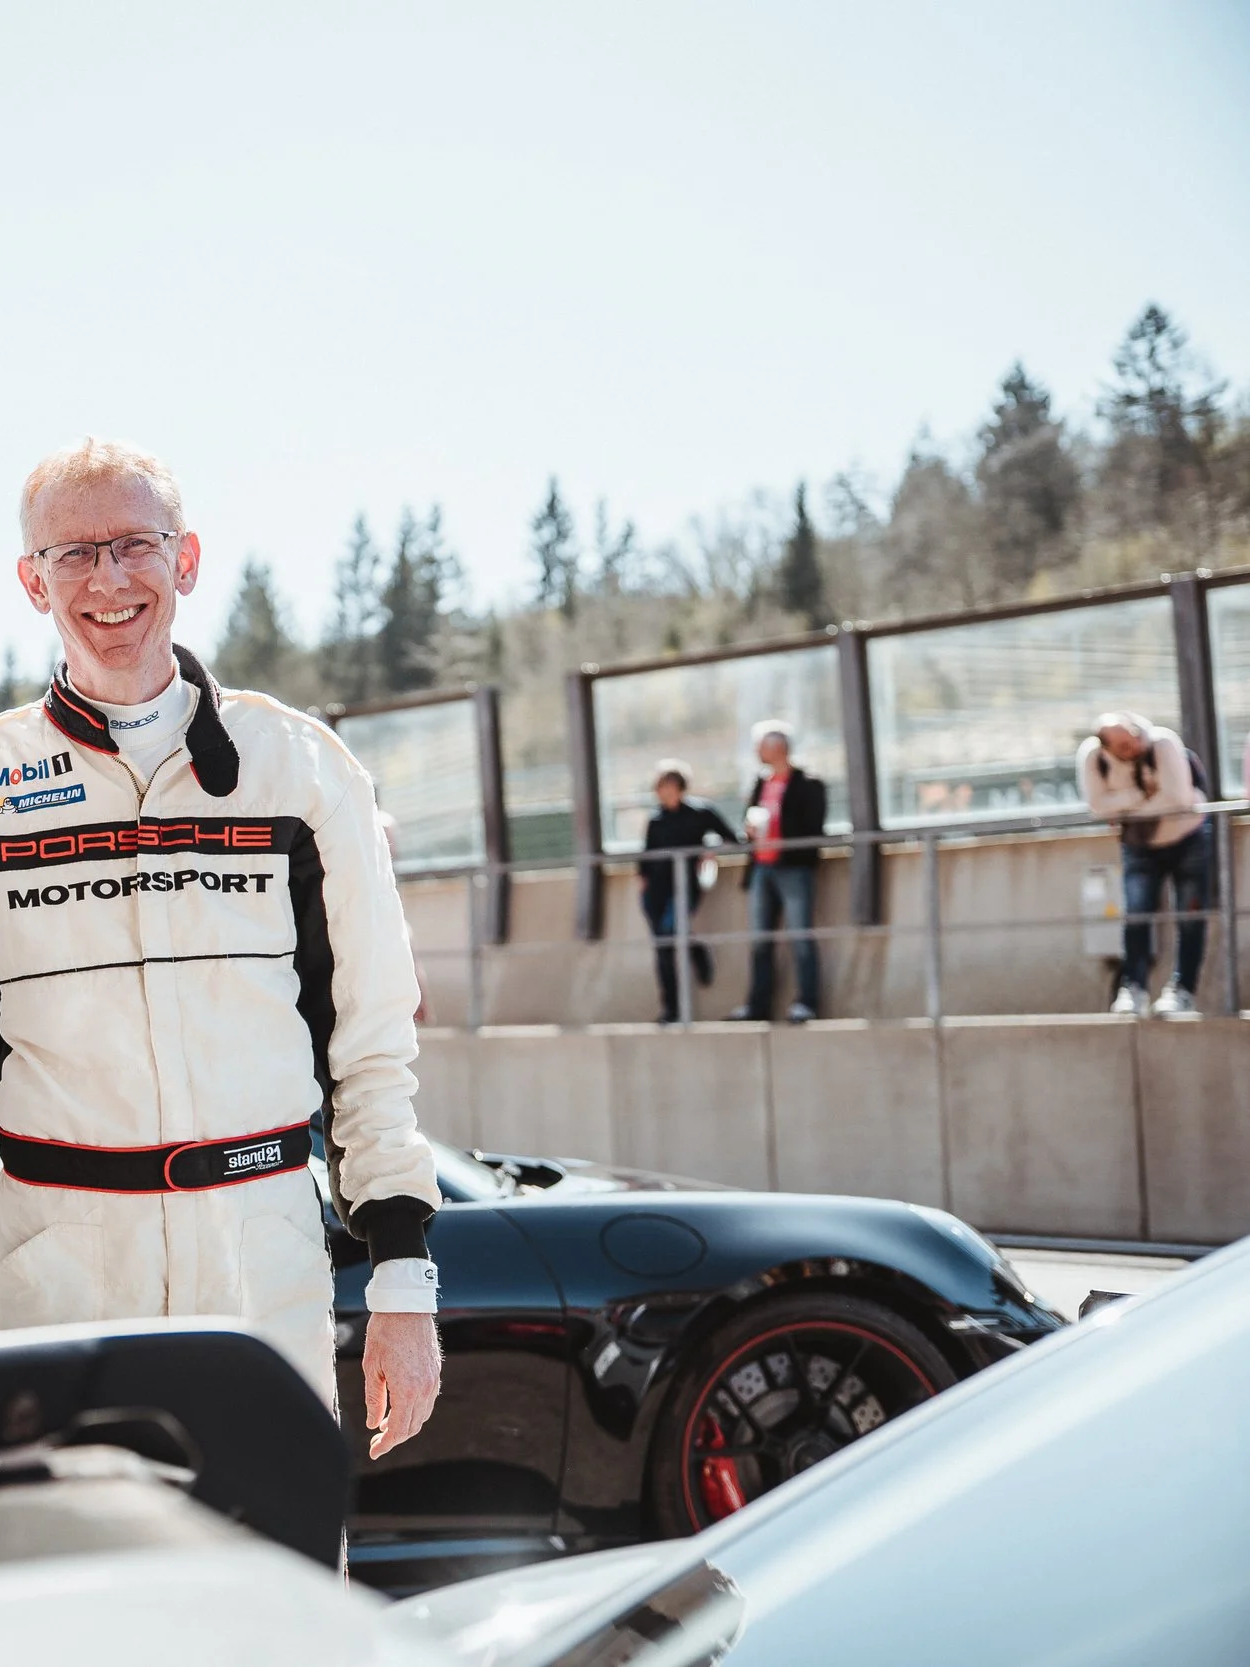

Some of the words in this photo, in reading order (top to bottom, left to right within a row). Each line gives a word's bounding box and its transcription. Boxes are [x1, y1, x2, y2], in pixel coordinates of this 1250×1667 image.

[110, 710, 159, 730] sparco
[54, 754, 70, 775] 1
[18, 788, 82, 808] MICHELIN
[0, 824, 273, 862] PORSCHE
[7, 869, 274, 910] MOTORSPORT
